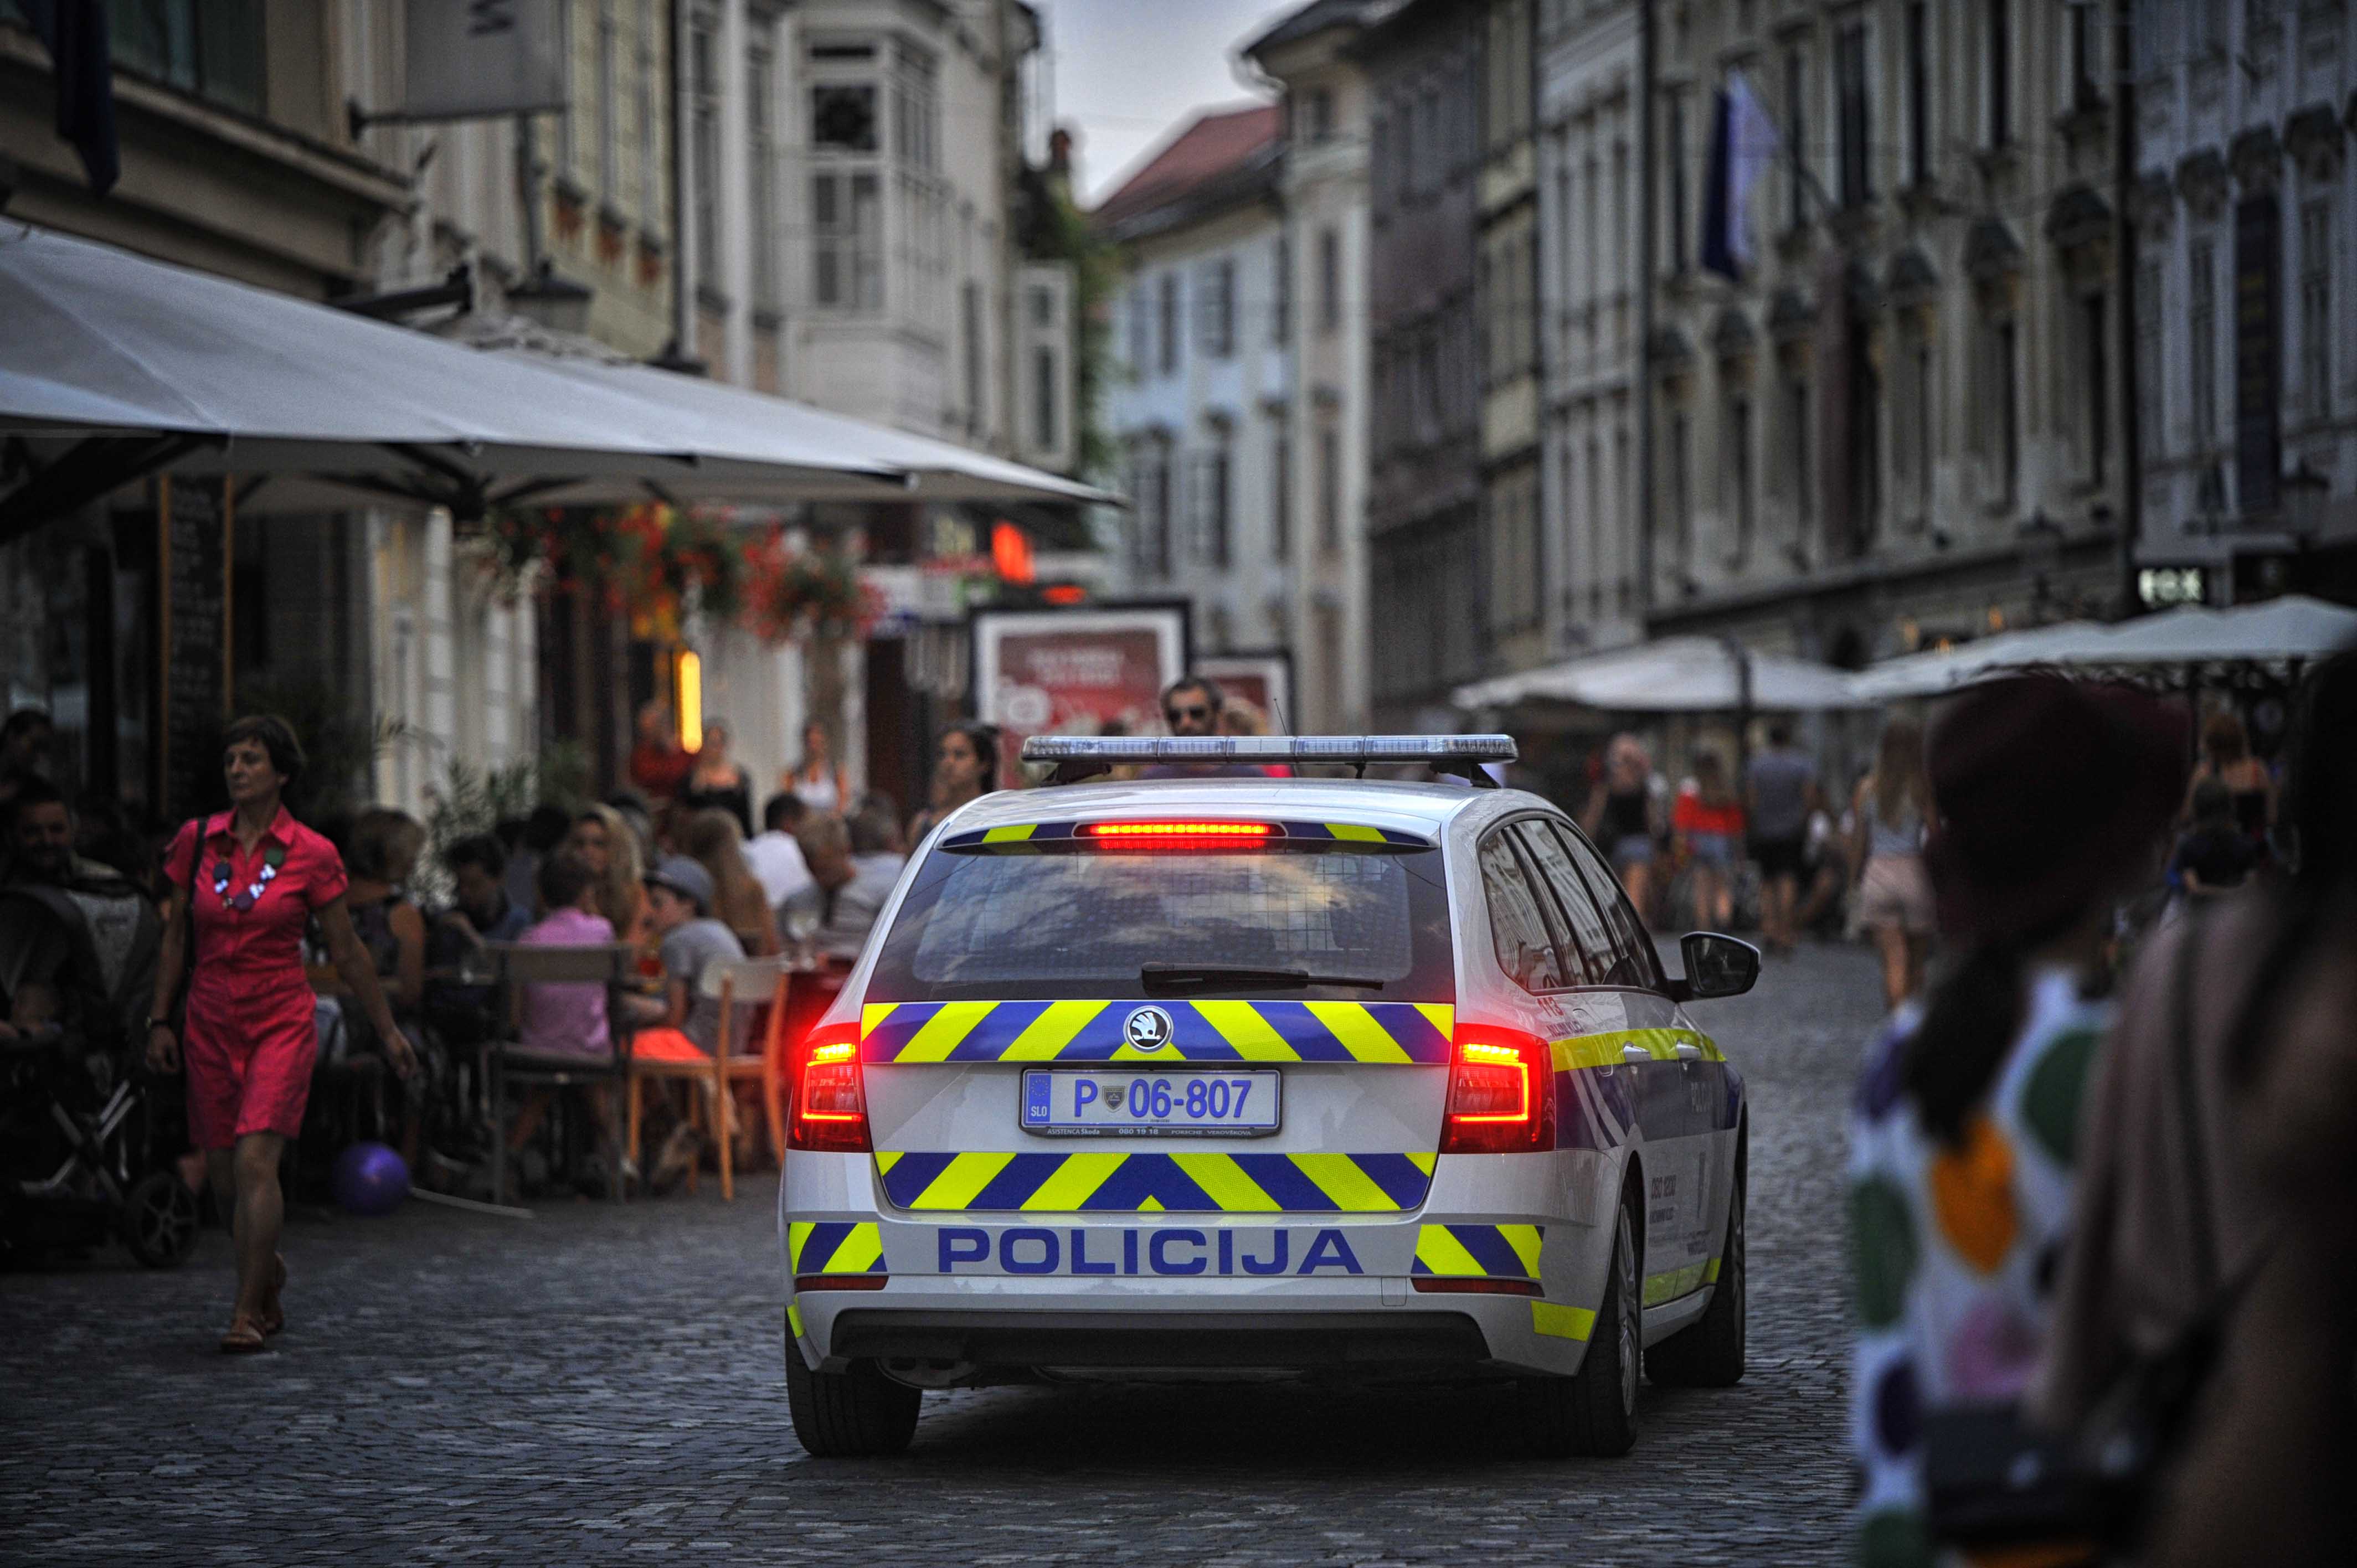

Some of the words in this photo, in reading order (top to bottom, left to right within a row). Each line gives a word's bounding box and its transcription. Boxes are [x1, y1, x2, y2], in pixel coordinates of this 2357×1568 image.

[1537, 996, 1565, 1018] 113
[1030, 1106, 1048, 1117] SLO
[1074, 1079, 1098, 1118] P
[1128, 1079, 1252, 1118] 06-807
[938, 1228, 1365, 1275] POLICIJA
